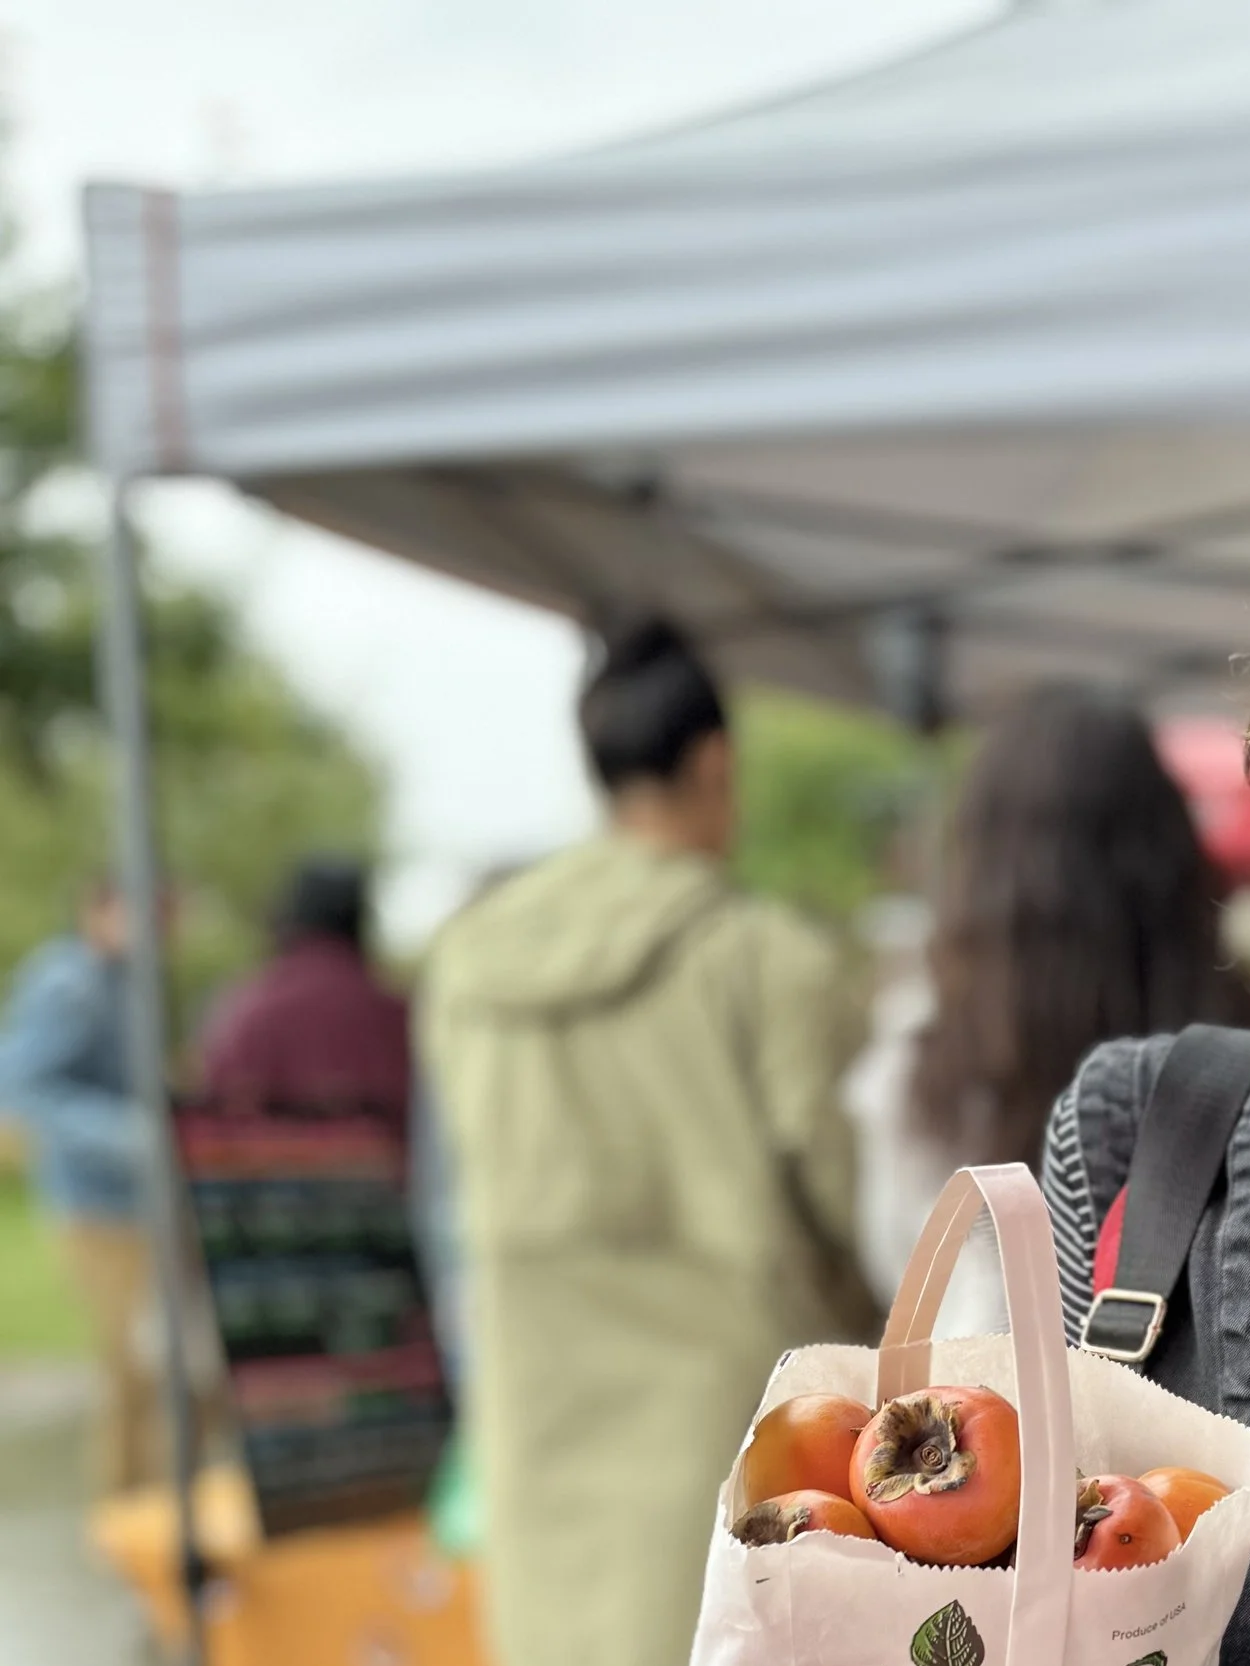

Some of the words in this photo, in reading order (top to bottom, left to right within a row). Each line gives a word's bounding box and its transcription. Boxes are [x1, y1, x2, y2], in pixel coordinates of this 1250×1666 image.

[1111, 1622, 1158, 1640] Produce
[1159, 1613, 1169, 1627] of
[1169, 1602, 1185, 1620] USA
